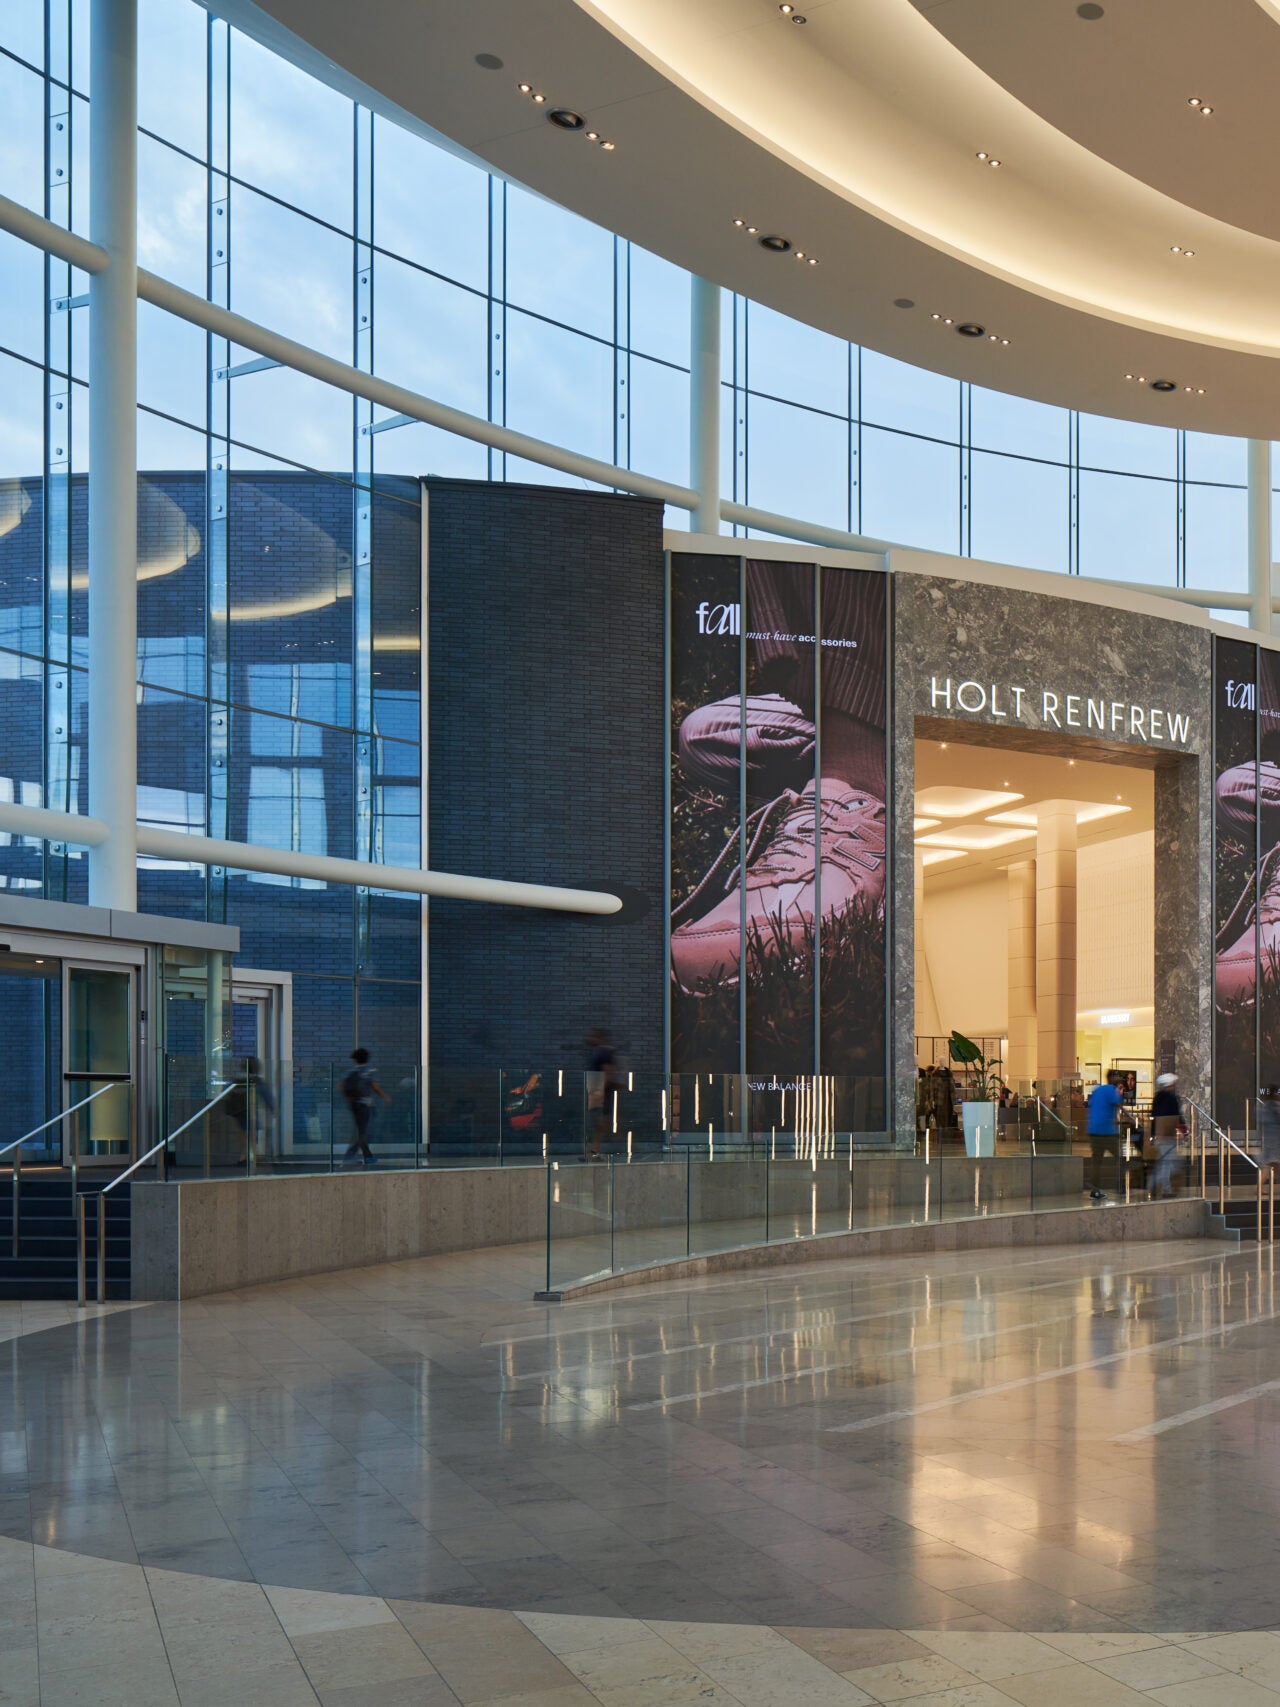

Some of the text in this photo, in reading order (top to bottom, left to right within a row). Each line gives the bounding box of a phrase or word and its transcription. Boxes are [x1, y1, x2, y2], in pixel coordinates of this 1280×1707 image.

[695, 601, 741, 636] fall
[745, 630, 858, 648] must-have accssories
[930, 676, 1191, 744] HOLT RENFREW
[1225, 679, 1255, 711] fall
[767, 1082, 812, 1091] BALANCE
